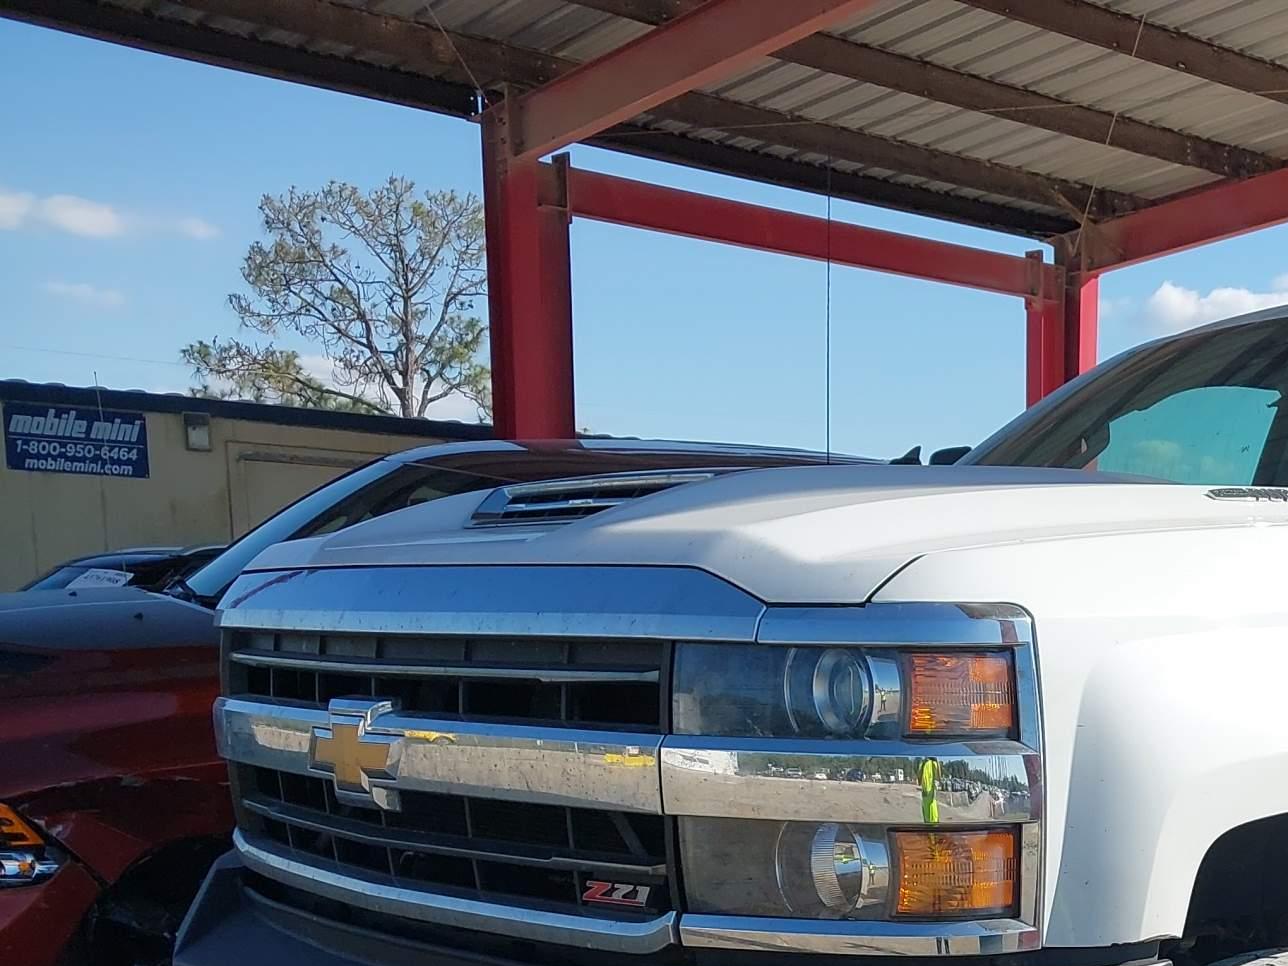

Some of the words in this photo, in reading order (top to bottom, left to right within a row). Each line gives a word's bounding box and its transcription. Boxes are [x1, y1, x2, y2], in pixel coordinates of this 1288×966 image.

[9, 409, 87, 437] mobile
[90, 418, 141, 442] mini
[15, 439, 138, 461] 1-800-950-6464
[24, 457, 133, 476] mobilemini.com
[582, 880, 651, 907] Z71
